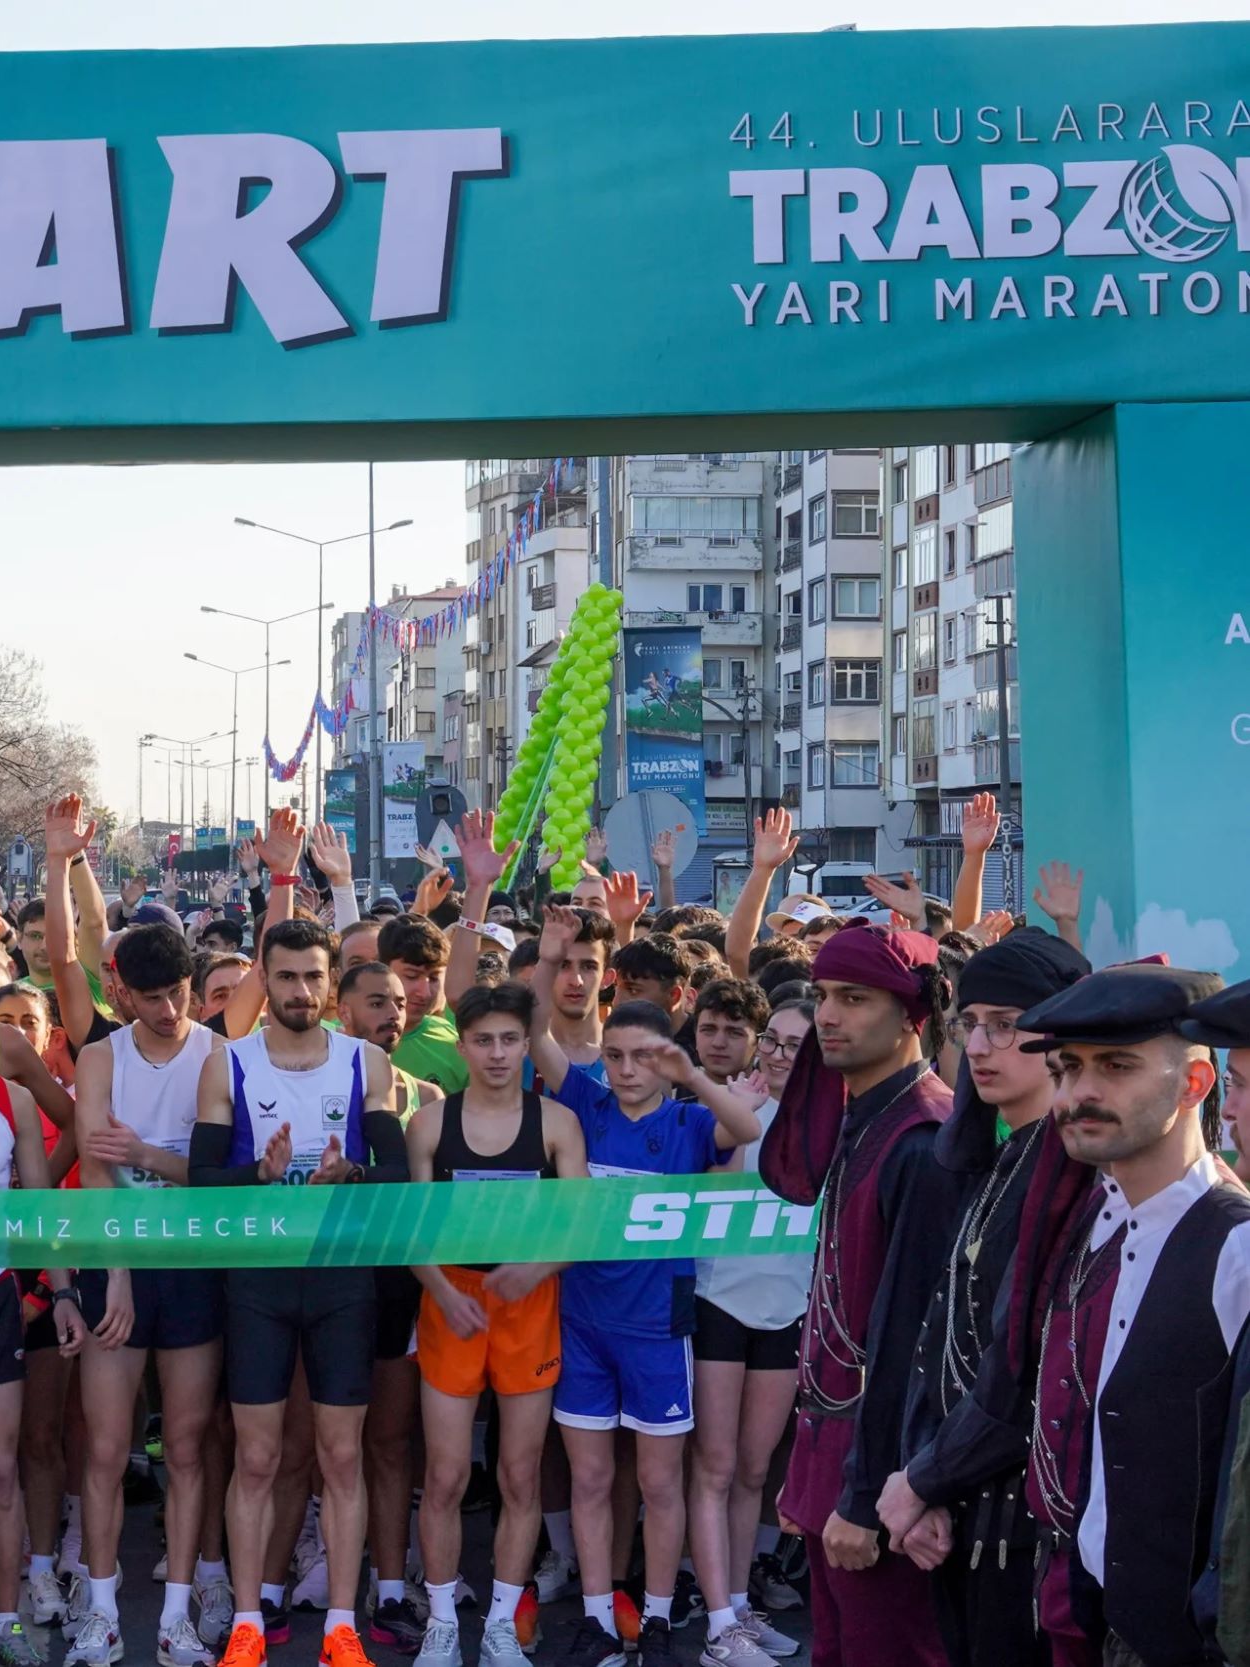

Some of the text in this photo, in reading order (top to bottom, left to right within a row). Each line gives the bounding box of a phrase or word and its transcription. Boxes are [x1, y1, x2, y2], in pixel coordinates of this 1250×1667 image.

[729, 111, 817, 149] 44.
[729, 144, 1250, 264] TRABZO
[731, 279, 890, 326] YARI
[631, 759, 699, 773] TRABZON
[104, 1216, 287, 1238] GELECEK
[623, 1189, 820, 1242] STA
